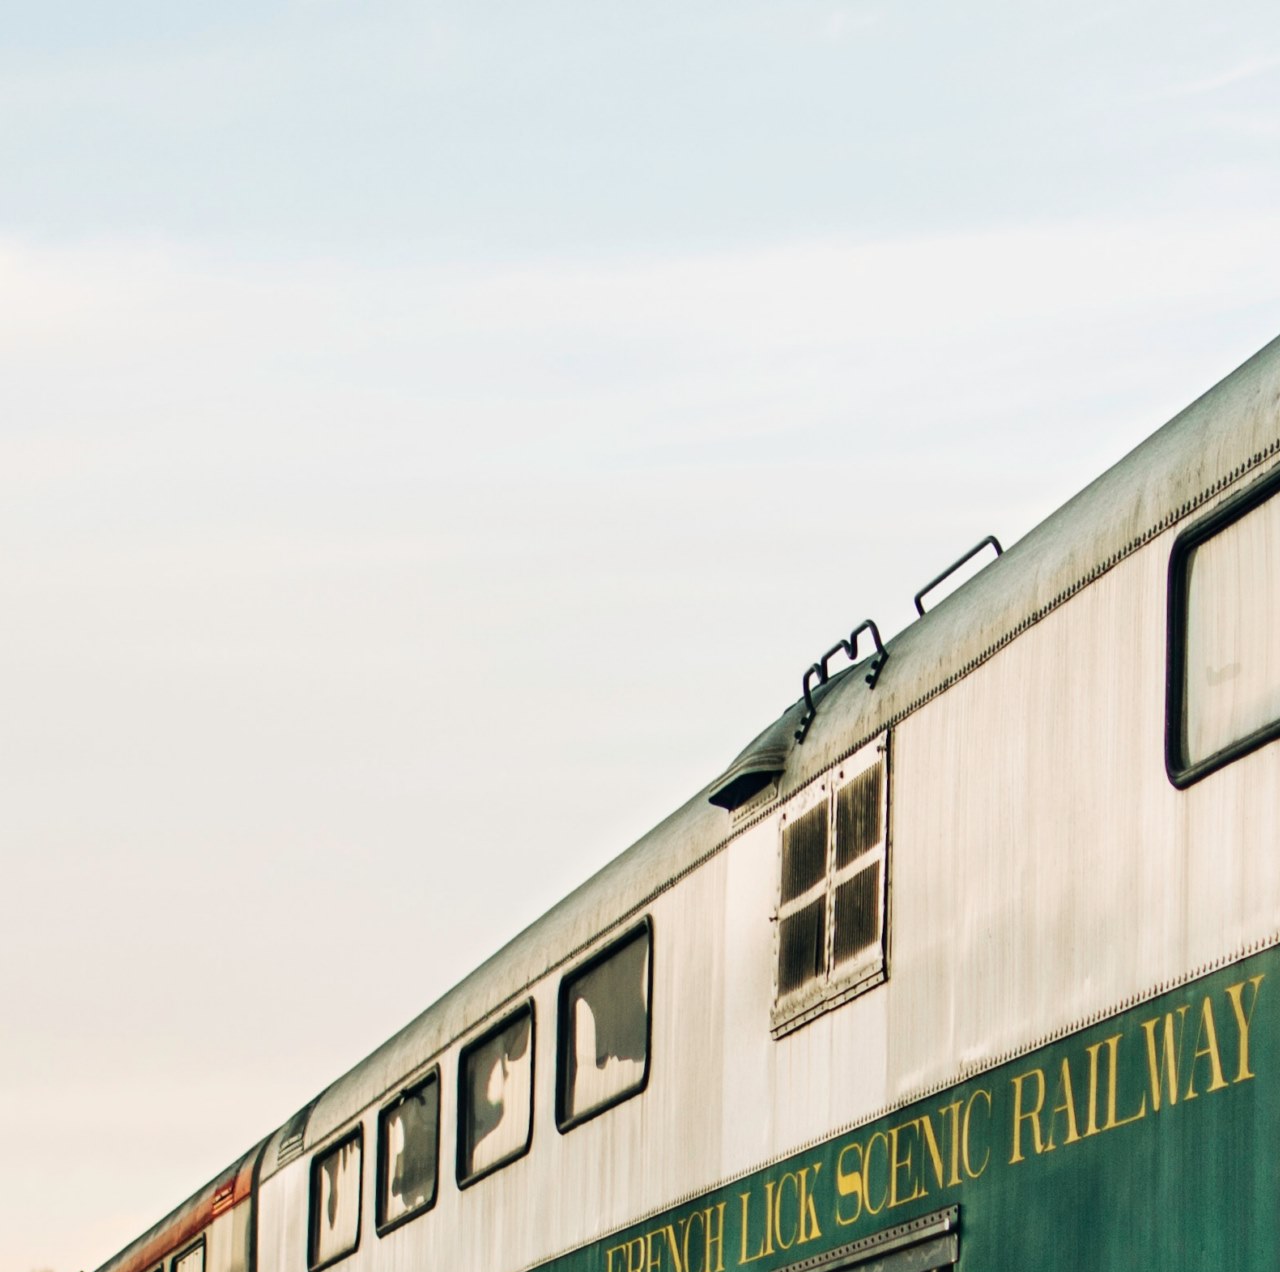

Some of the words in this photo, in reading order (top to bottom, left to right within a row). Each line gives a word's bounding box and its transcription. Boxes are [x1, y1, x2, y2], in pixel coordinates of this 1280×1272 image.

[738, 1162, 822, 1265] LICK
[835, 1089, 992, 1226] SCENIC
[1007, 974, 1265, 1166] RAILWAY
